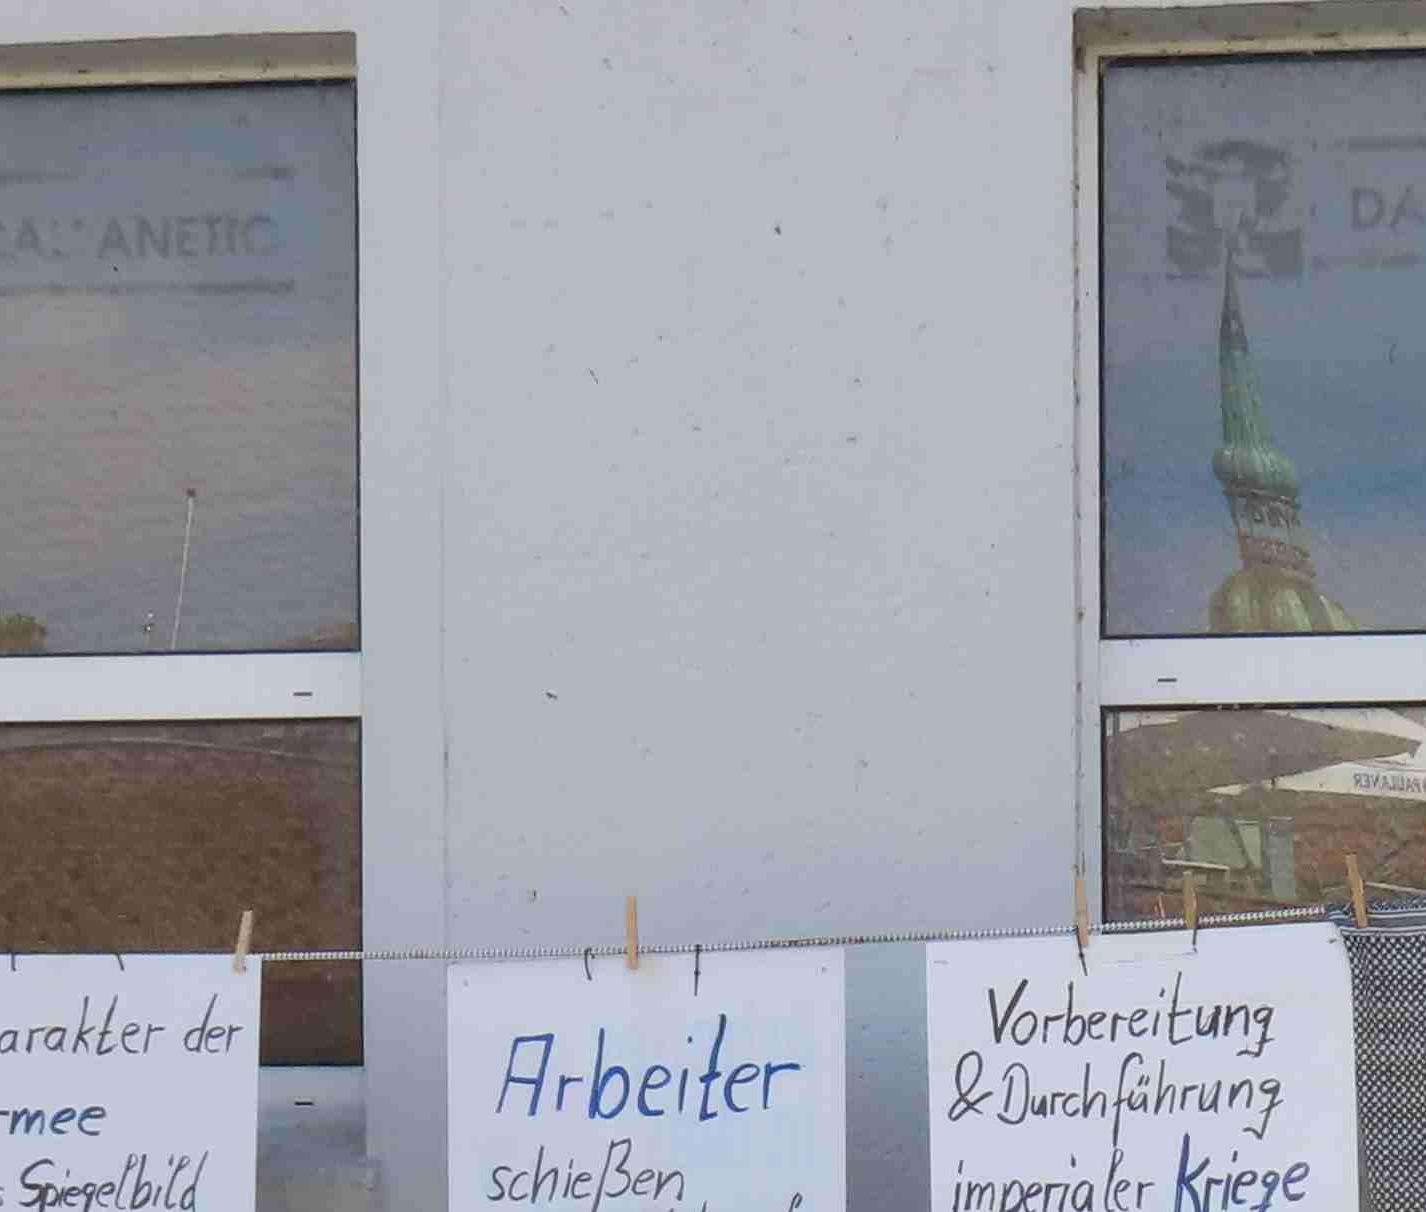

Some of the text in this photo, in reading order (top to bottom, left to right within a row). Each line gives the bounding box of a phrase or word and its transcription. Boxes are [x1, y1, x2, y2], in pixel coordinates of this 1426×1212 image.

[183, 993, 244, 1055] der
[987, 970, 1276, 1057] Vorbereitung
[494, 1012, 802, 1122] Arbeiter
[947, 1050, 1286, 1149] & Durchführung
